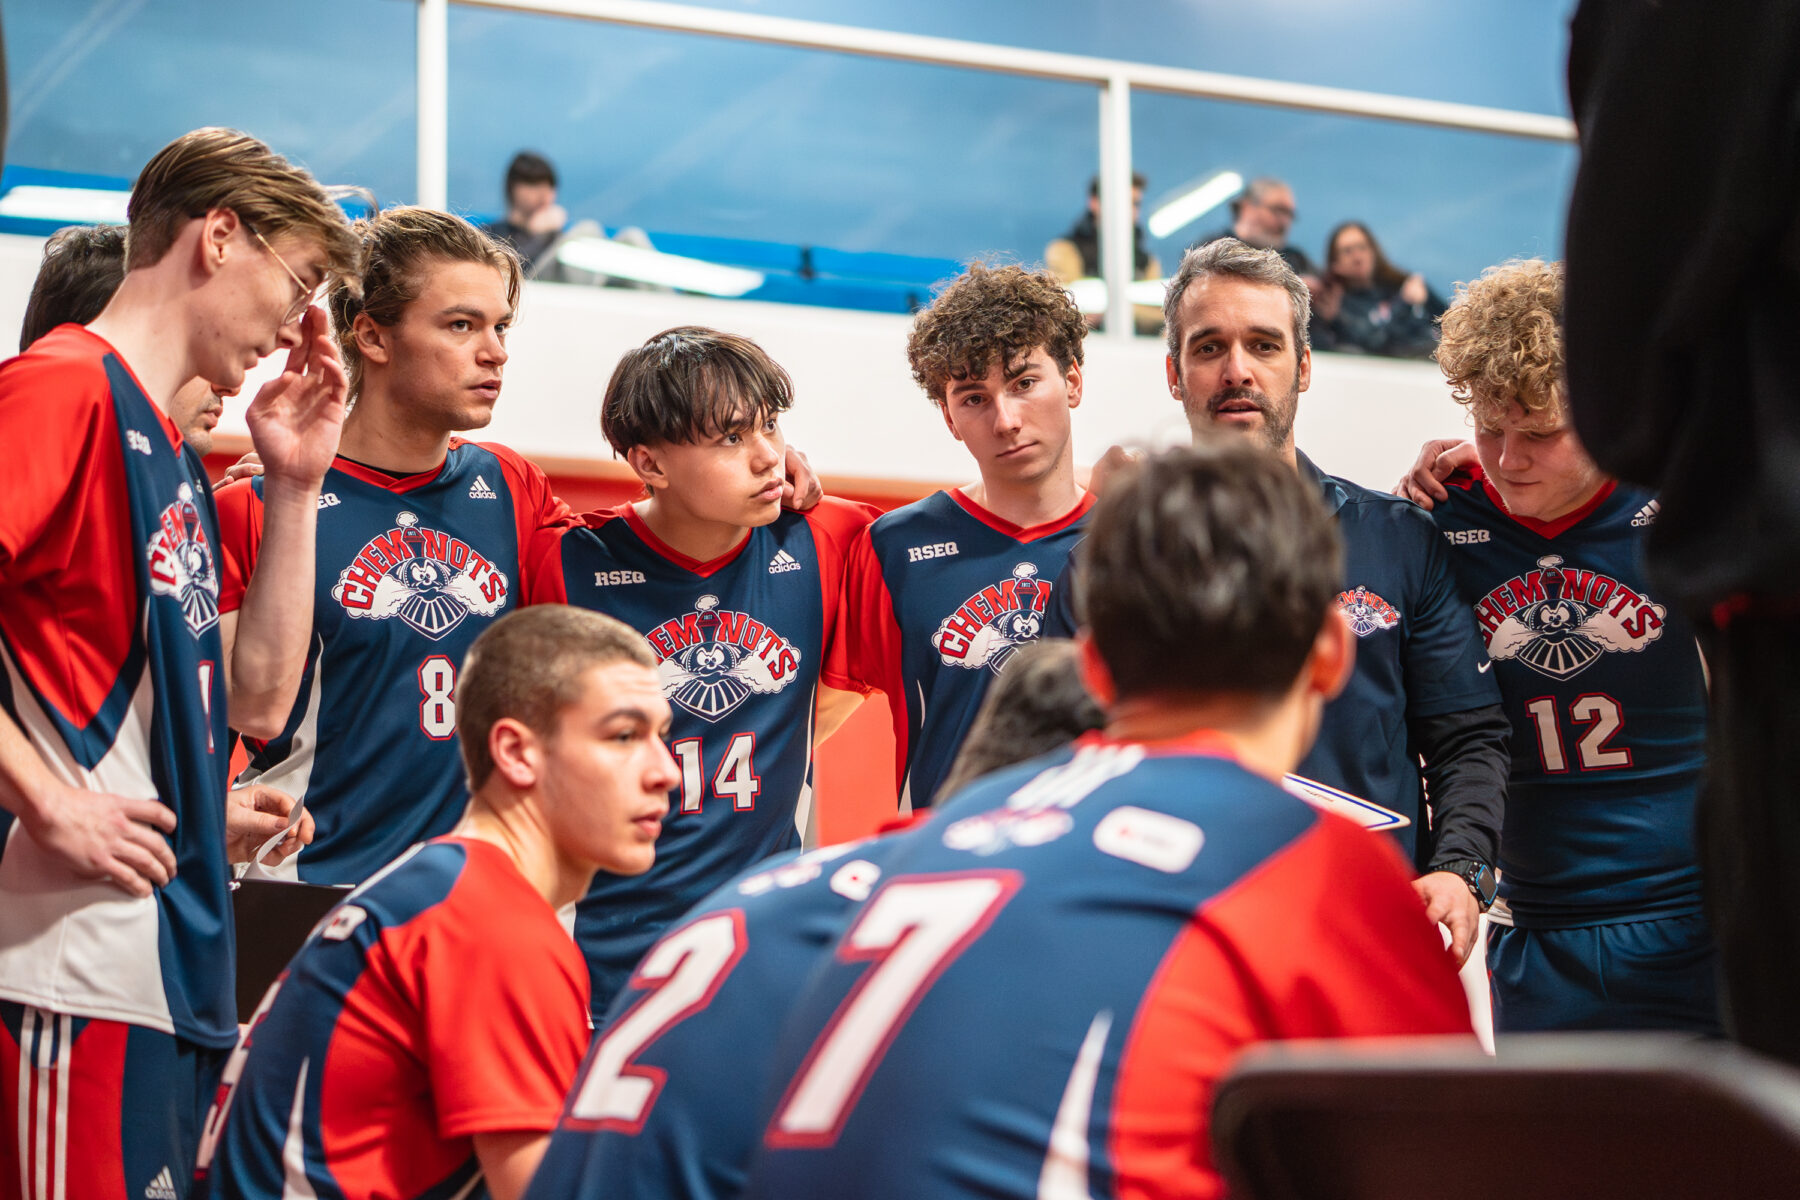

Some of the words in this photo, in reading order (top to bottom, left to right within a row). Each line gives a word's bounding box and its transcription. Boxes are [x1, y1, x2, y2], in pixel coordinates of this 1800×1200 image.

[317, 492, 341, 510] EQ
[469, 490, 497, 500] adidas
[769, 562, 801, 574] adidas
[907, 541, 960, 563] RSEQ
[594, 570, 647, 587] RSEQ
[417, 654, 457, 741] 8
[1524, 692, 1634, 775] 12
[672, 731, 761, 815] 14
[562, 907, 749, 1135] 2
[765, 868, 1026, 1149] 7
